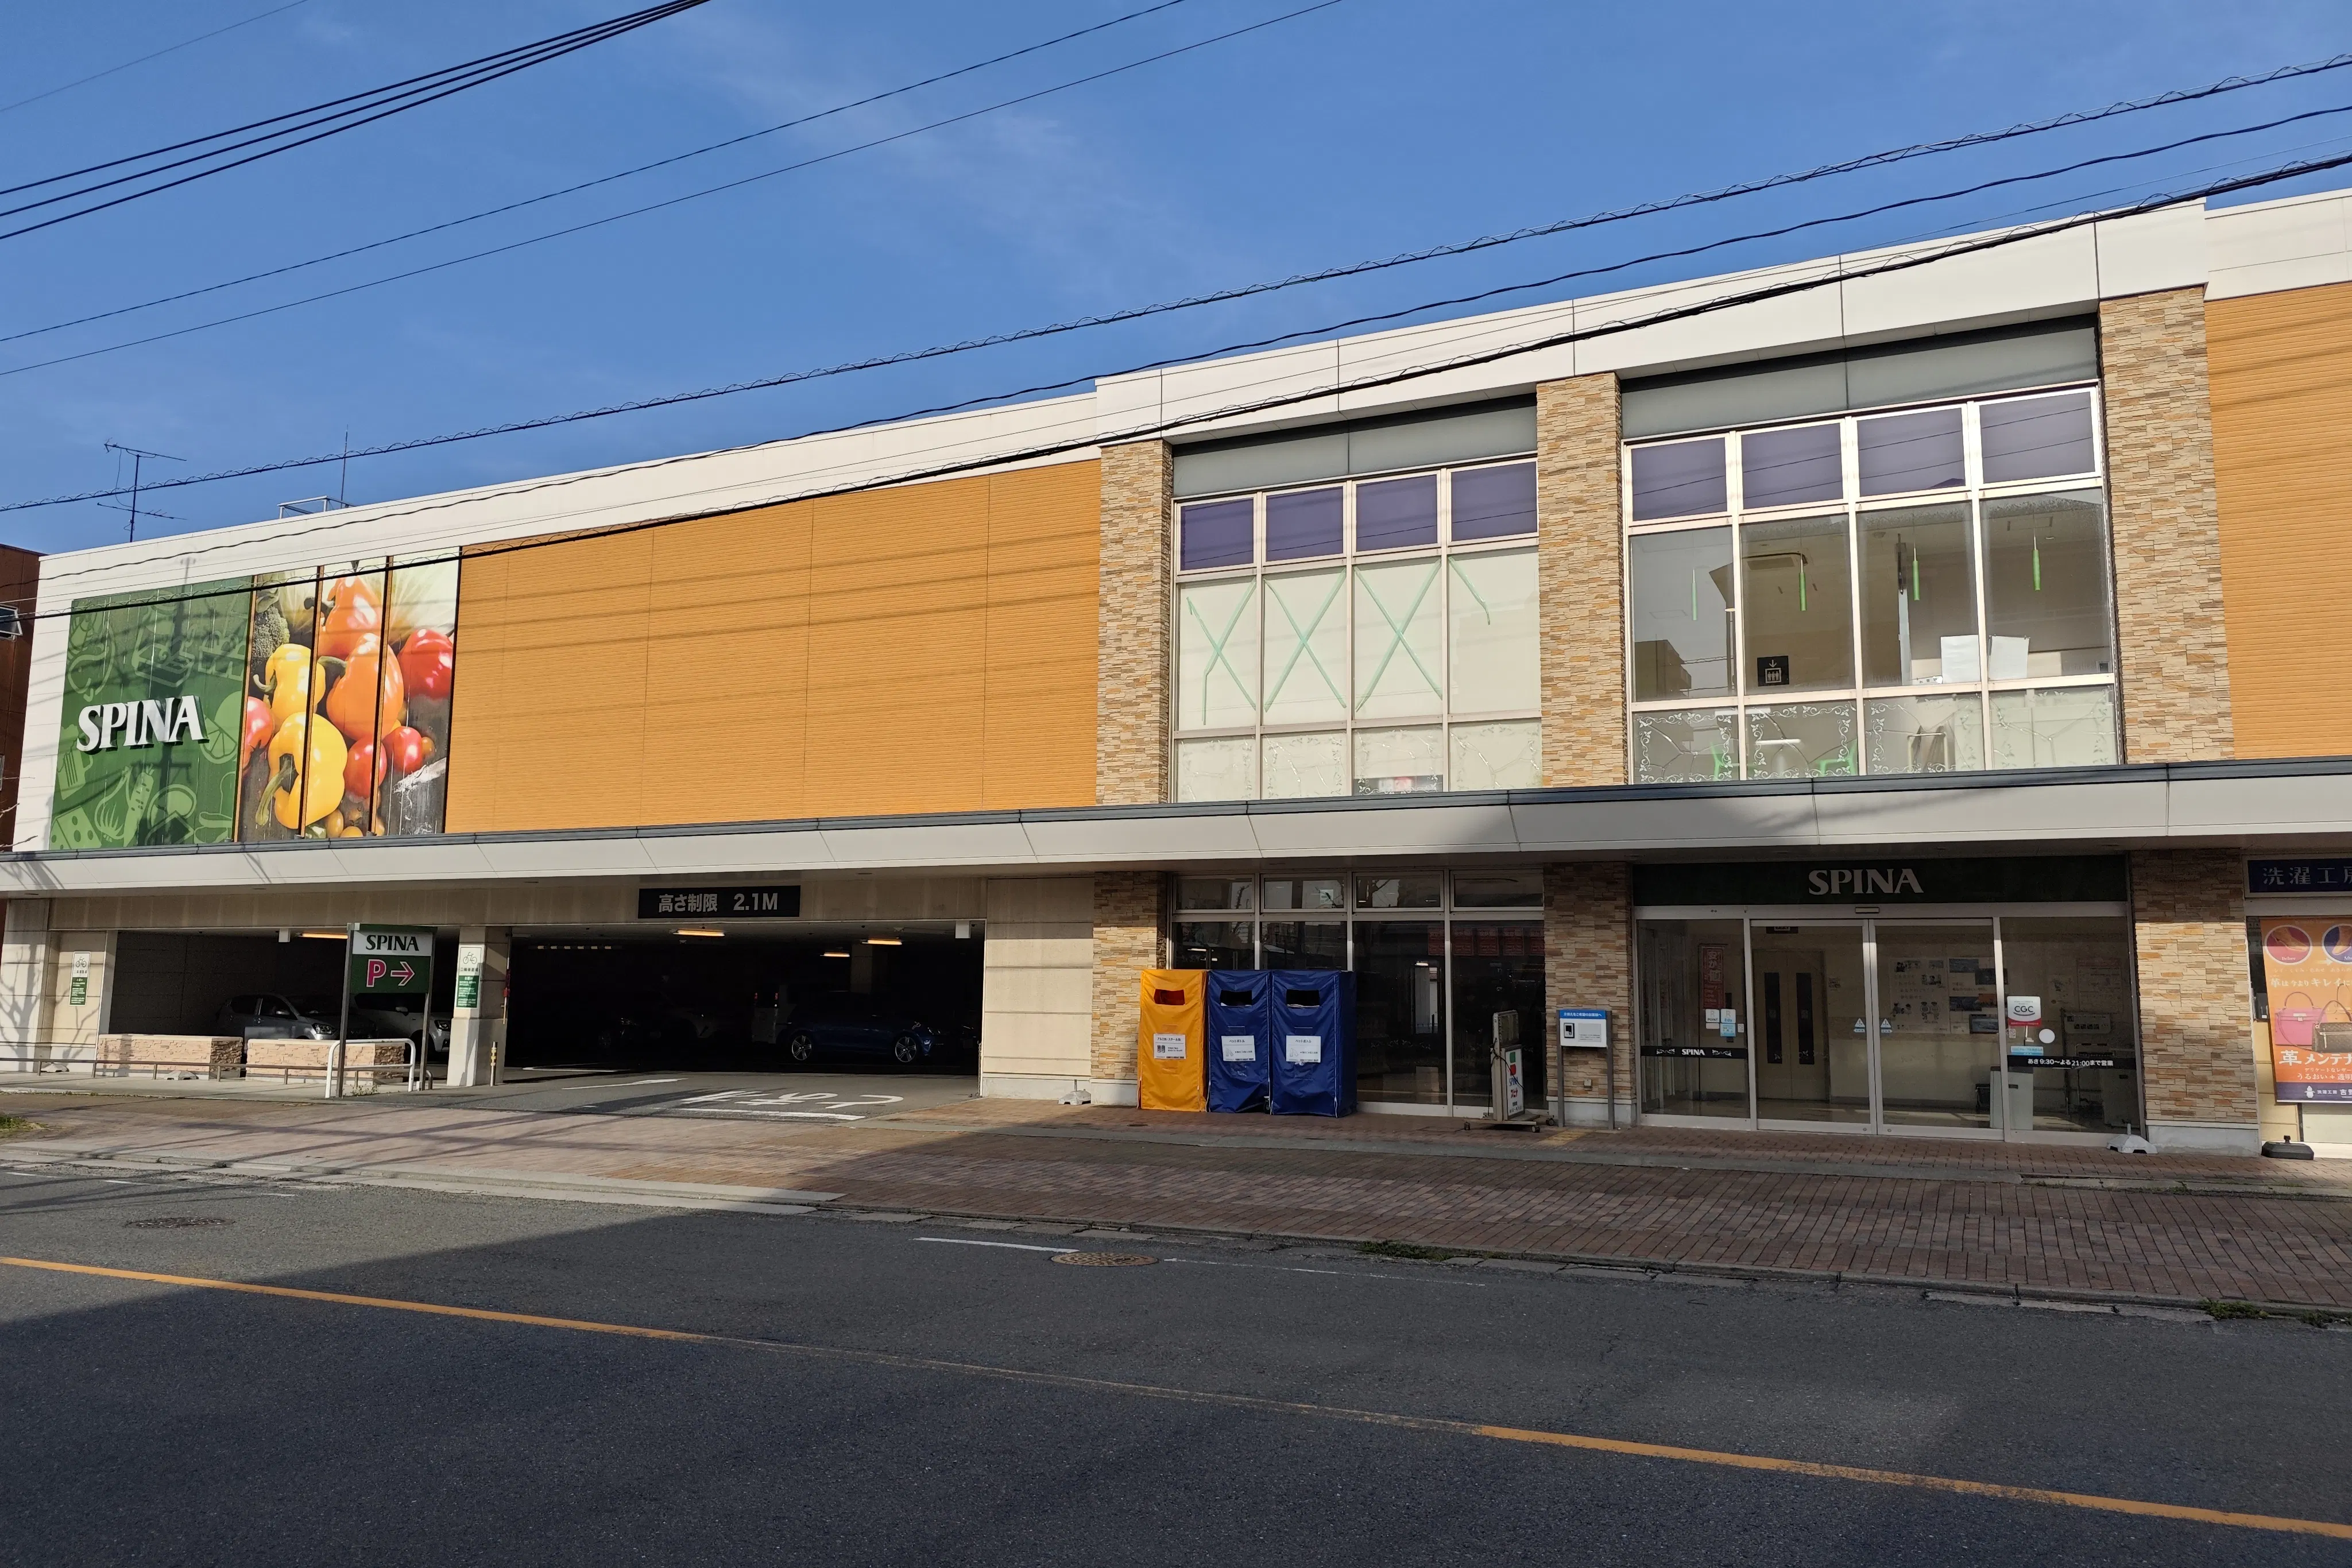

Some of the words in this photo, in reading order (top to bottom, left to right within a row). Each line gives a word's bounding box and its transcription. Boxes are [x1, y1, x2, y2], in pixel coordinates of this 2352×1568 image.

[76, 695, 209, 753] SPINA
[1808, 868, 1924, 895] SPINA
[659, 893, 718, 913] 高さ制限
[733, 892, 778, 911] 2.1M
[365, 935, 419, 951] SPINA
[366, 959, 386, 987] P
